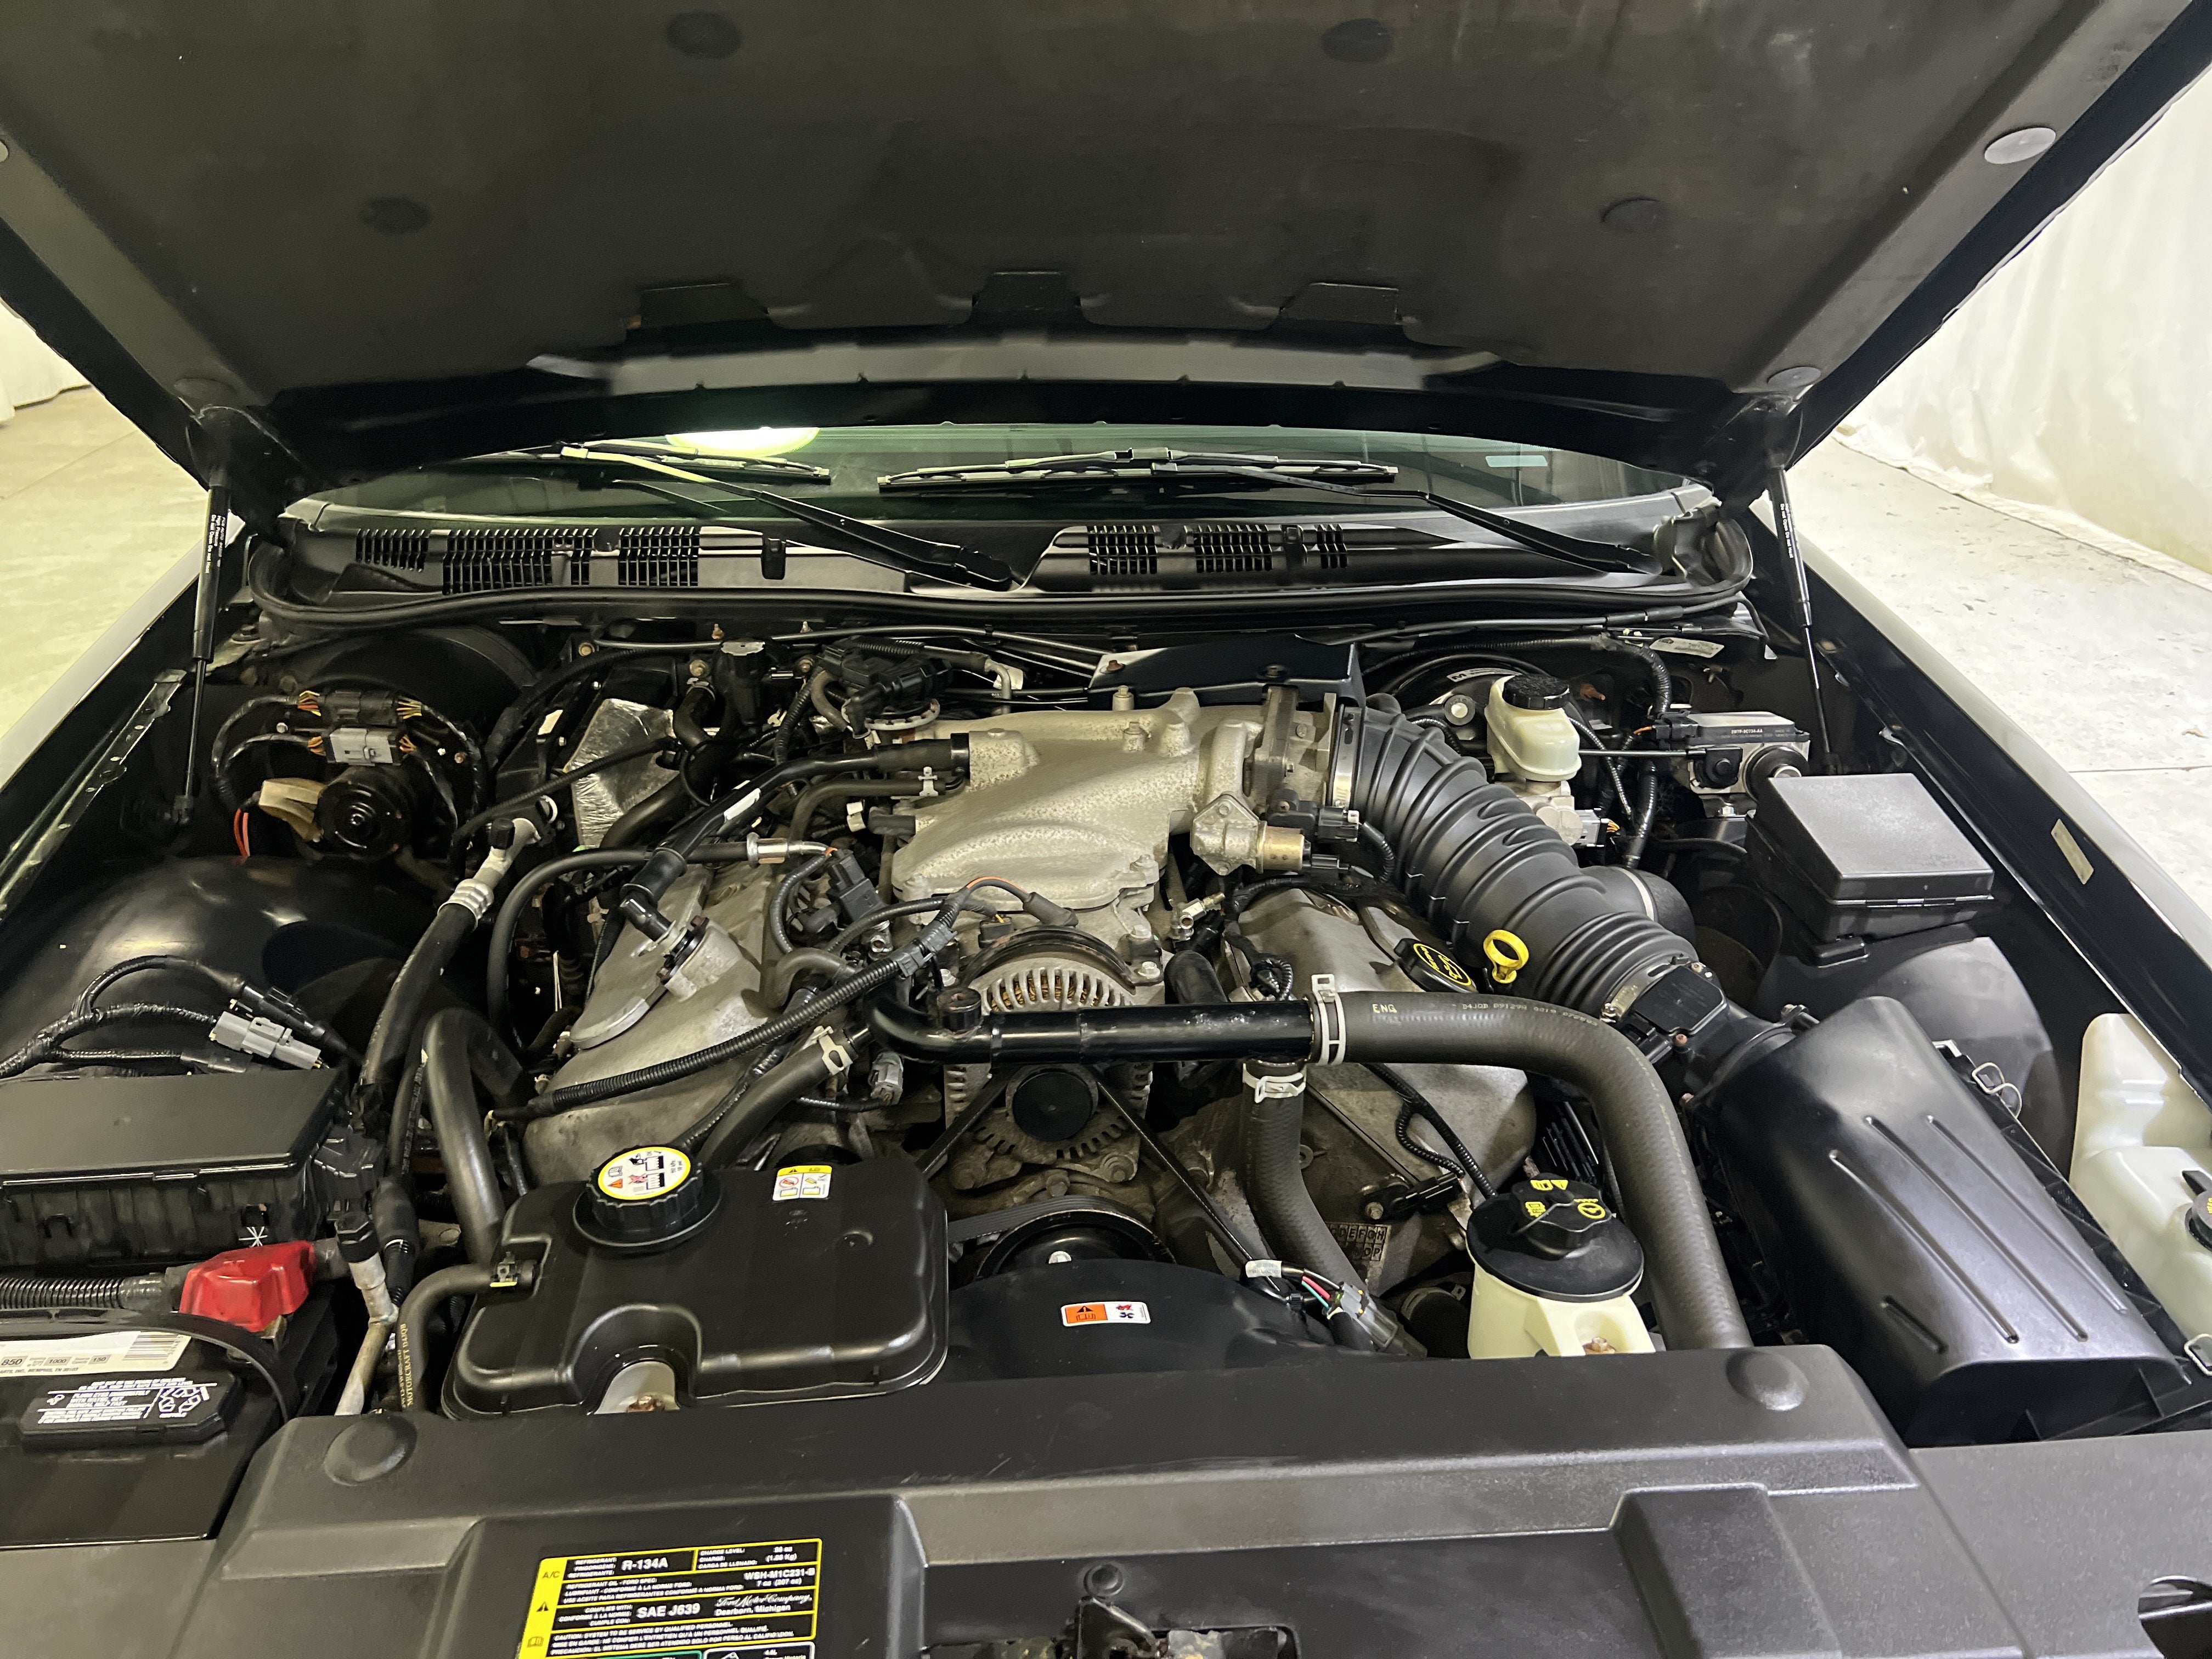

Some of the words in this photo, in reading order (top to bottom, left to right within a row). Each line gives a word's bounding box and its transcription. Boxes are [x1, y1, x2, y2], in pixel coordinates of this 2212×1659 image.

[1373, 1004, 1397, 1013] ENG
[403, 1349, 413, 1406] MOTORCRAFT
[621, 1557, 668, 1571] R-134A
[636, 1605, 667, 1618] SAE
[668, 1603, 701, 1617] J639
[715, 1607, 753, 1616] Dearborn,
[754, 1605, 791, 1613] Michigan
